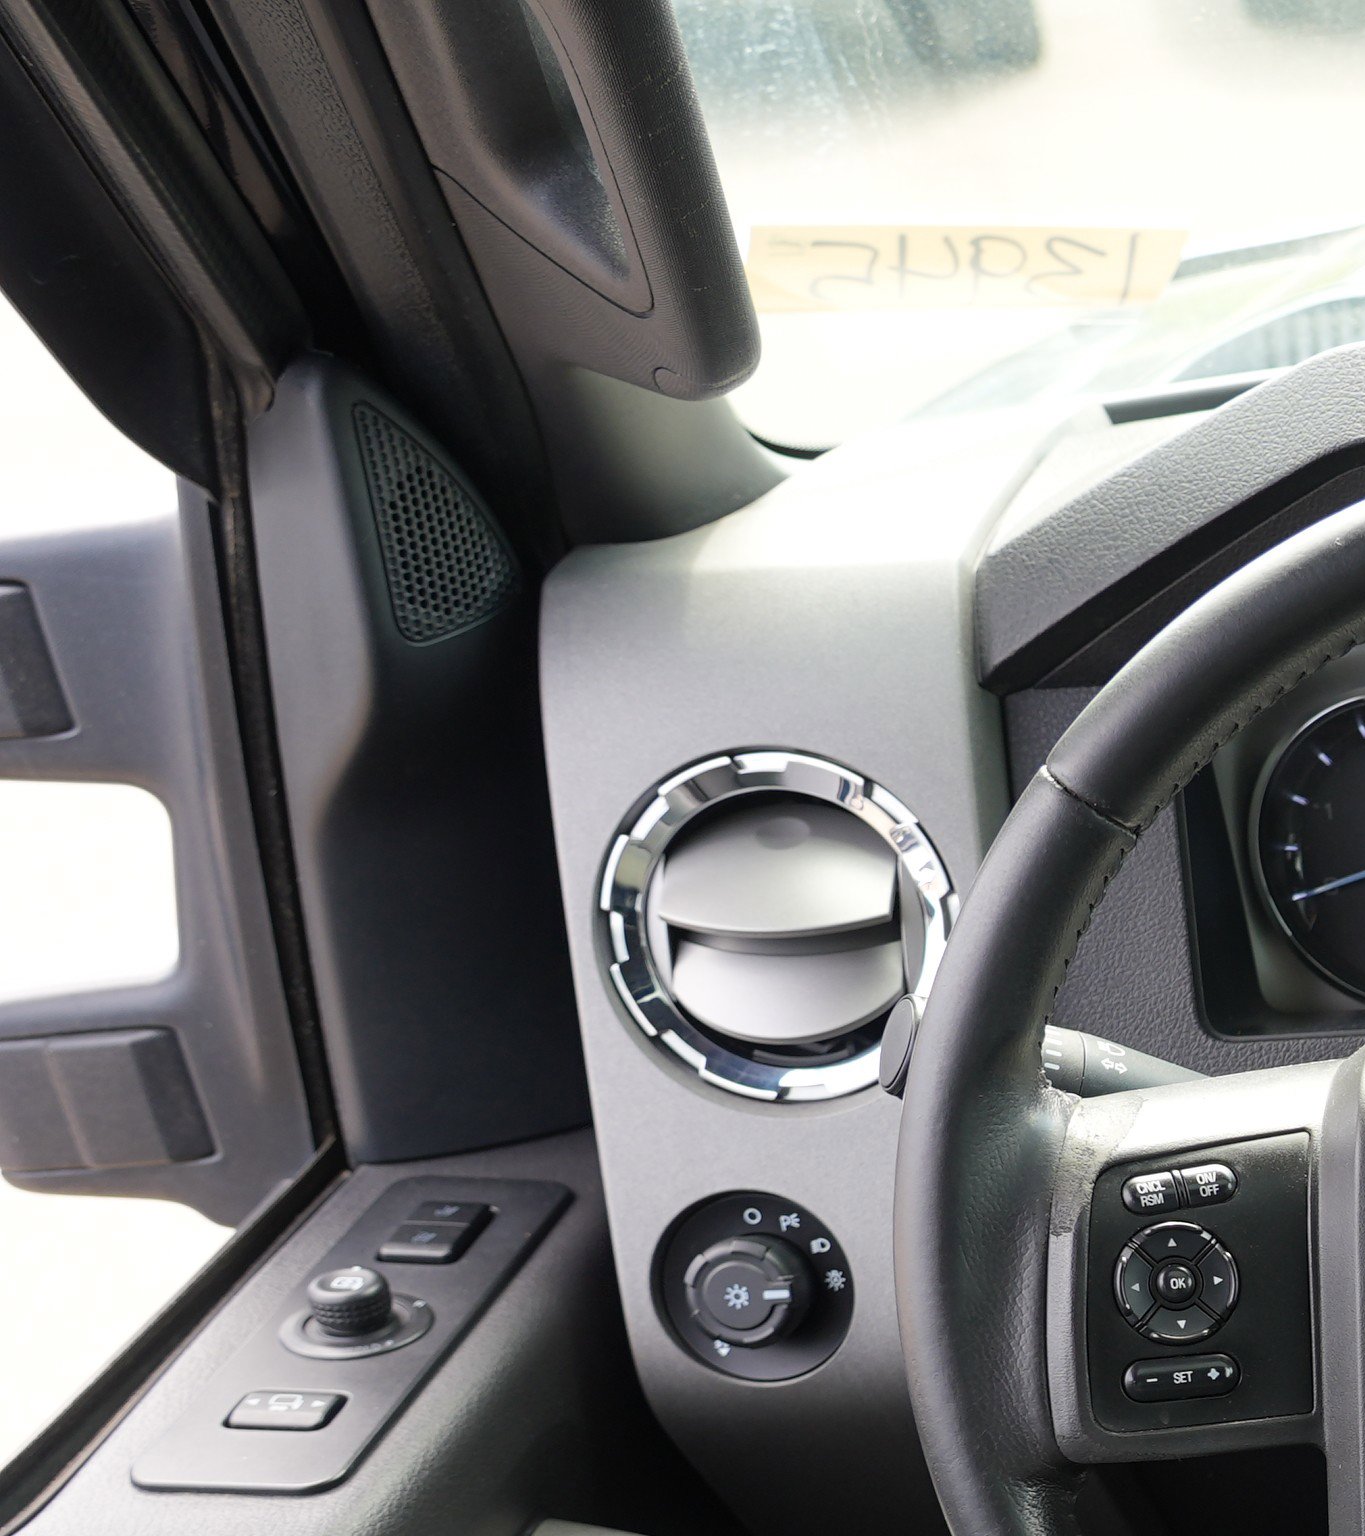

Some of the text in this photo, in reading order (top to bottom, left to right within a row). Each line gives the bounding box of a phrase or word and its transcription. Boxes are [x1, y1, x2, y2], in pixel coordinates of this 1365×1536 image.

[1196, 1171, 1216, 1185] ON/
[1136, 1180, 1165, 1195] CNCL
[1200, 1185, 1220, 1198] OFF
[1140, 1194, 1164, 1207] RSM
[1170, 1277, 1186, 1290] OK
[1173, 1371, 1193, 1384] SET
